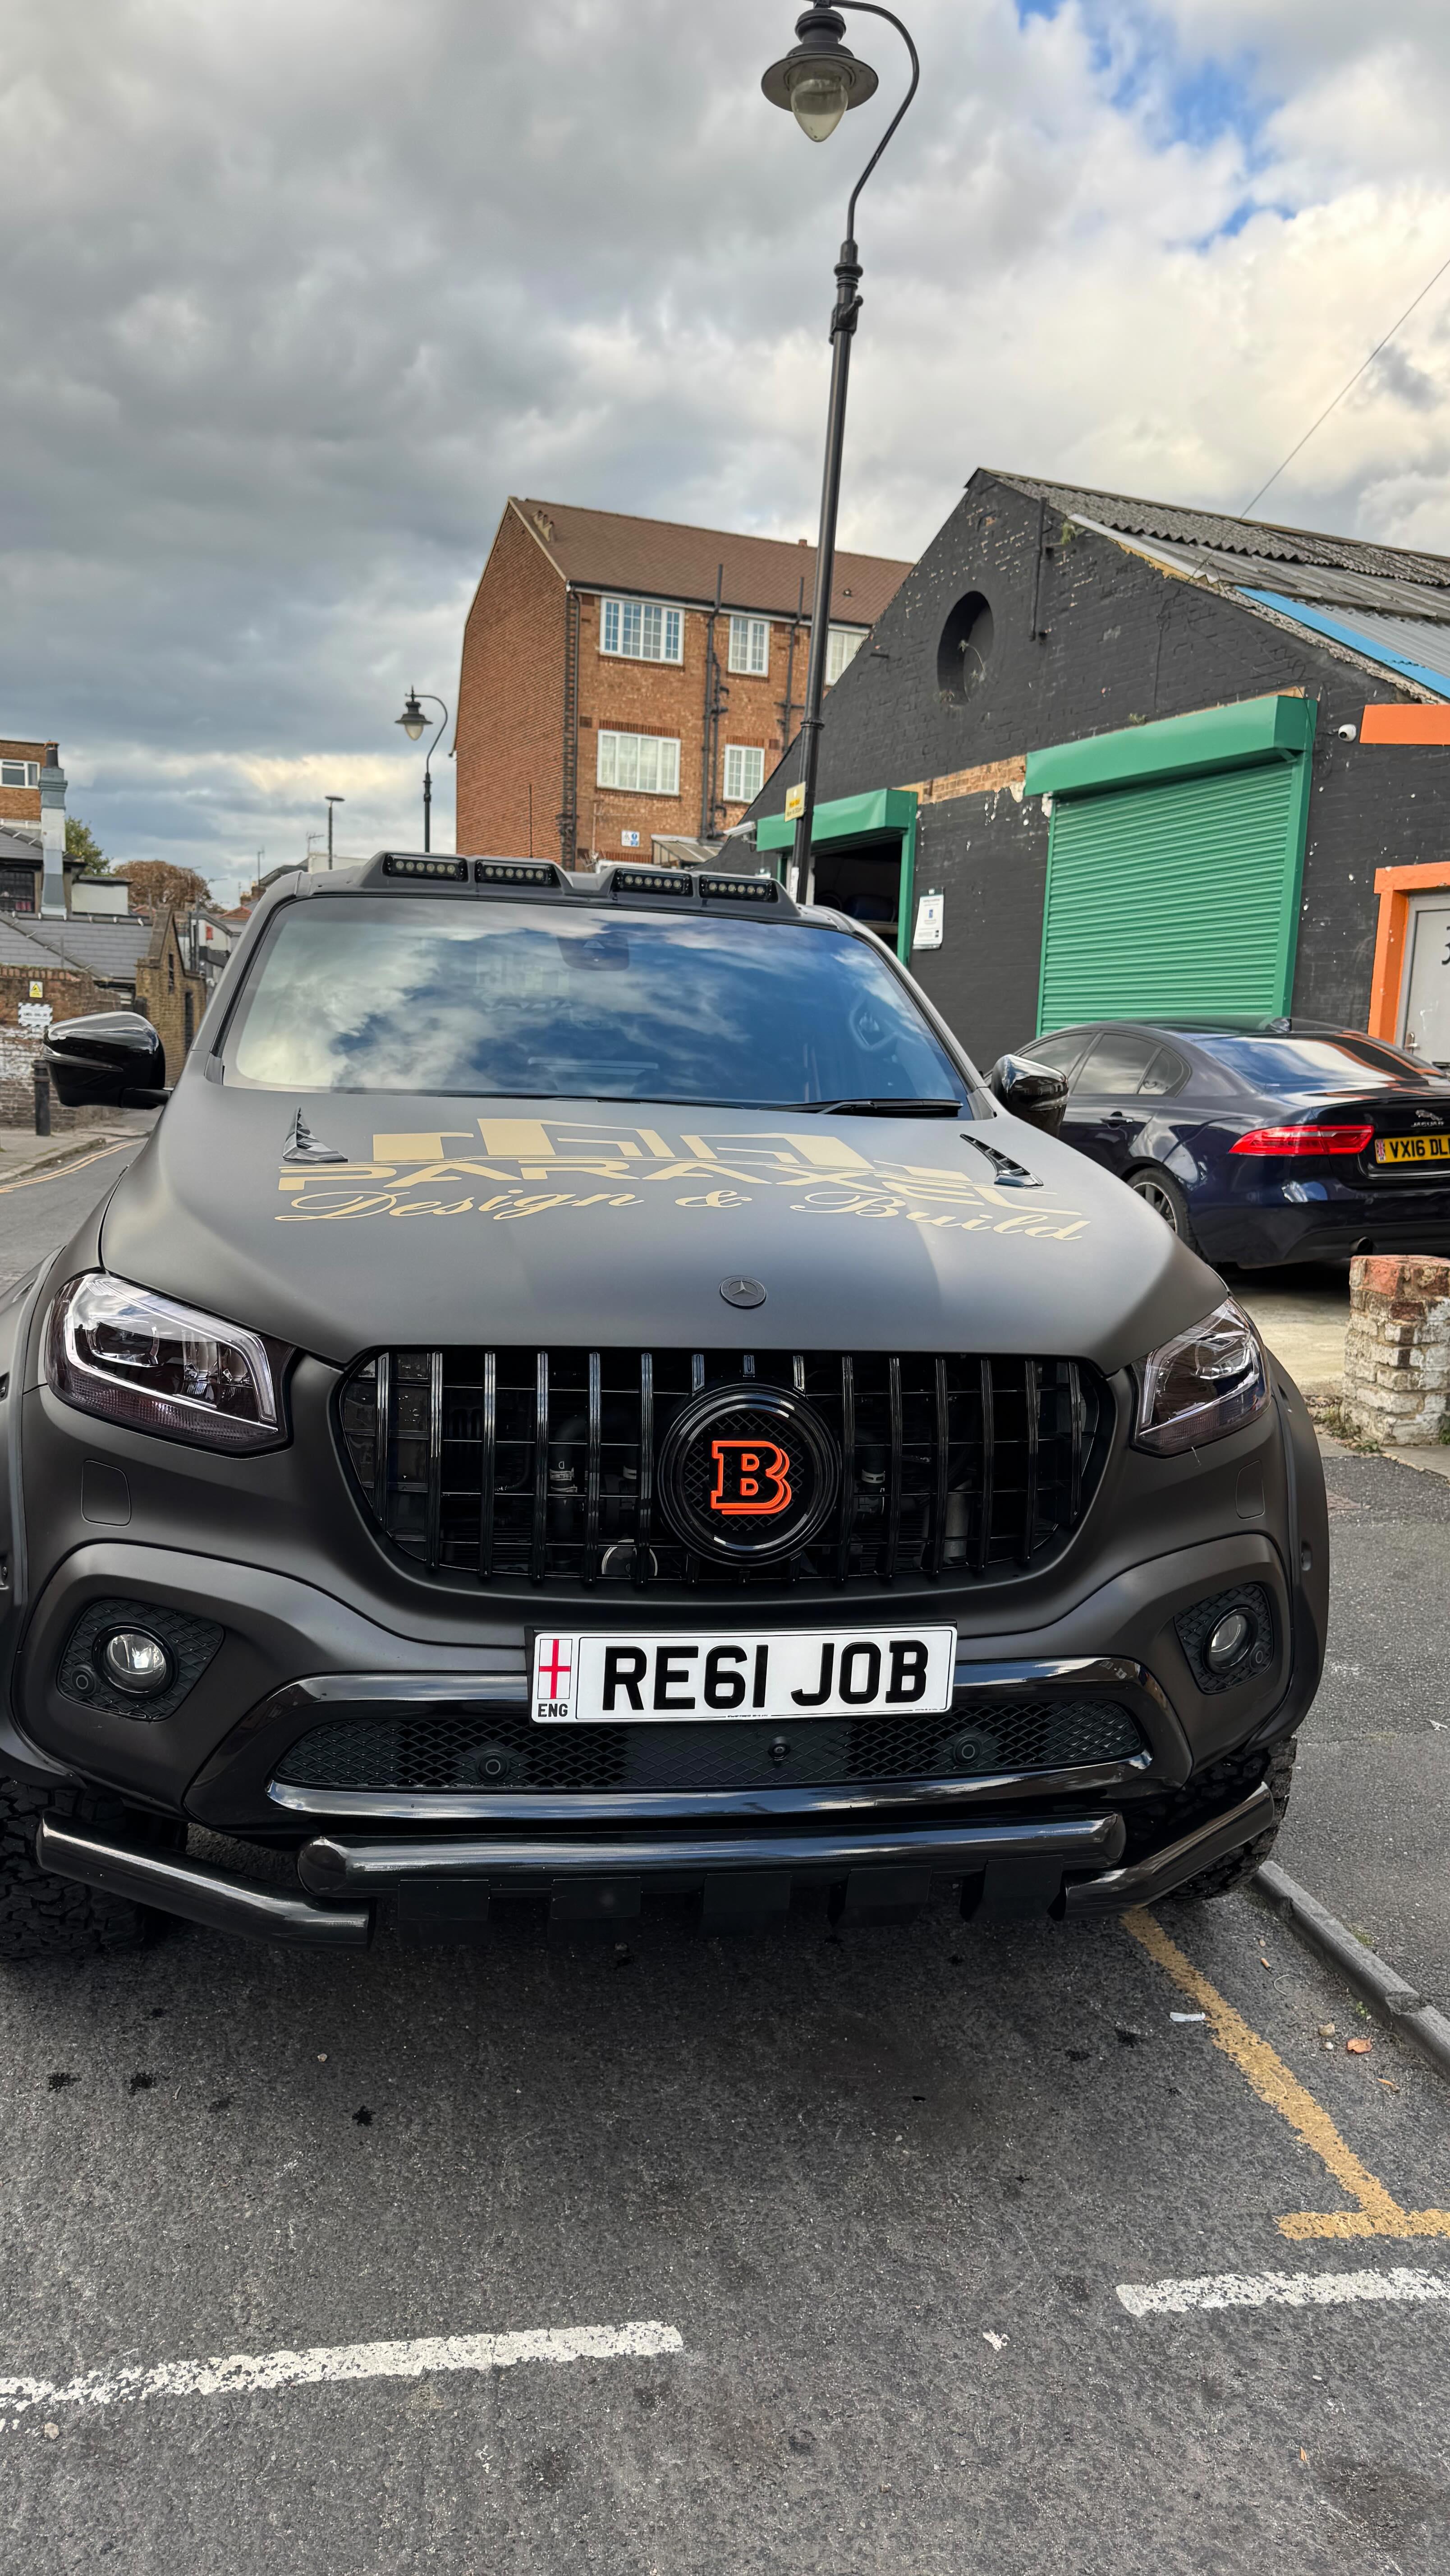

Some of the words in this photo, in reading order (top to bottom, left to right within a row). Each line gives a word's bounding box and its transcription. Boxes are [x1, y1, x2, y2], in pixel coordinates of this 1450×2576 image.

[1389, 1139, 1425, 1159] VX16
[1429, 1138, 1450, 1155] DL
[277, 1159, 1083, 1216] PARAXEL
[274, 1189, 644, 1221] Design
[675, 1190, 753, 1208] &
[789, 1191, 1091, 1241] Build
[710, 1440, 792, 1515] B
[602, 1644, 768, 1711] RE61
[790, 1639, 929, 1707] JOB
[538, 1703, 568, 1717] ENG
